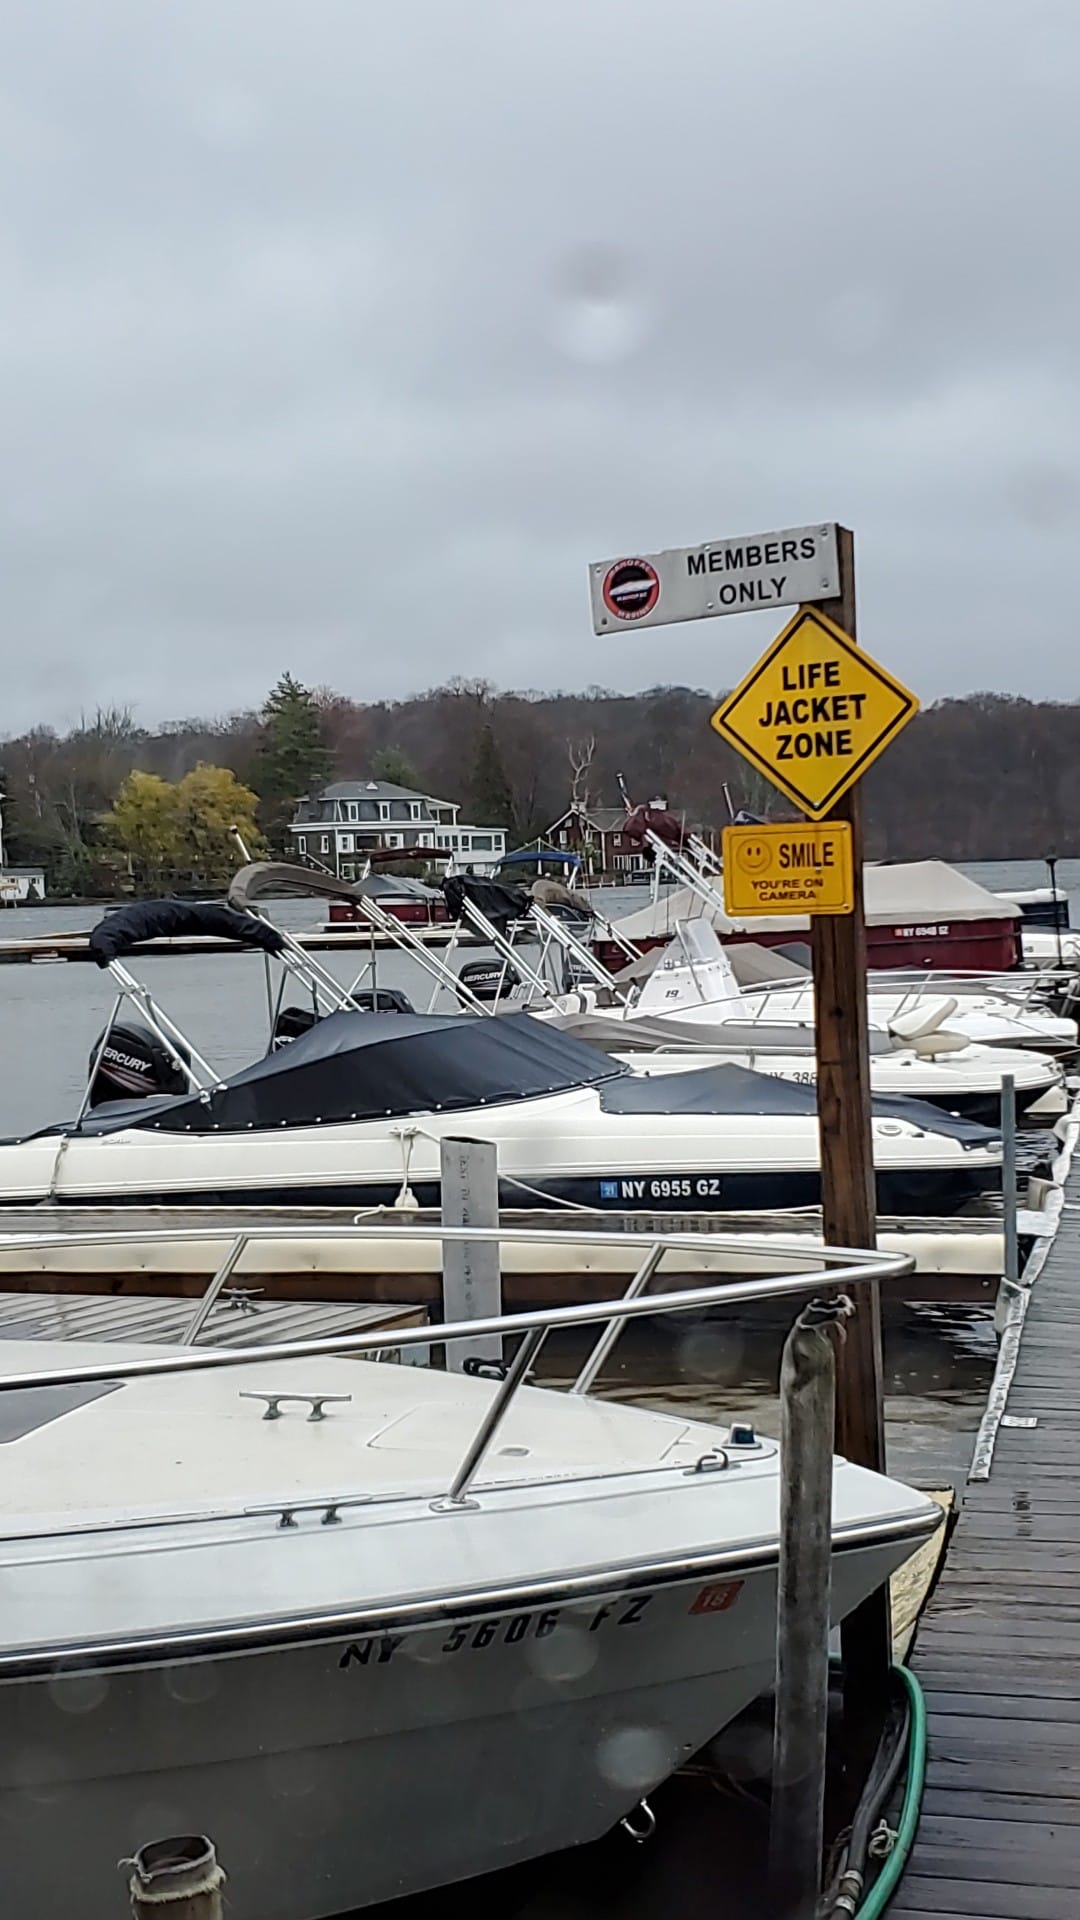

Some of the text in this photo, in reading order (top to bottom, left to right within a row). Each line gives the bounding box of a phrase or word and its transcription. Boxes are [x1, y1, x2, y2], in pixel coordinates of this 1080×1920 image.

[687, 537, 816, 576] MEMBERS
[719, 576, 788, 605] ONLY
[782, 660, 841, 691] LIFE
[758, 693, 867, 727] JACKET
[776, 729, 853, 760] ZONE
[779, 842, 834, 869] SMILE
[751, 878, 823, 890] YOU'RE ON
[758, 890, 817, 901] CAMERA
[463, 971, 503, 983] MERCURY
[665, 989, 680, 998] 19
[102, 1047, 153, 1072] ERCURY
[621, 1180, 646, 1199] NY
[650, 1180, 692, 1197] 6955
[696, 1179, 721, 1196] GZ
[338, 1637, 406, 1669] NY
[442, 1608, 561, 1653] 5606
[588, 1594, 654, 1632] FZ
